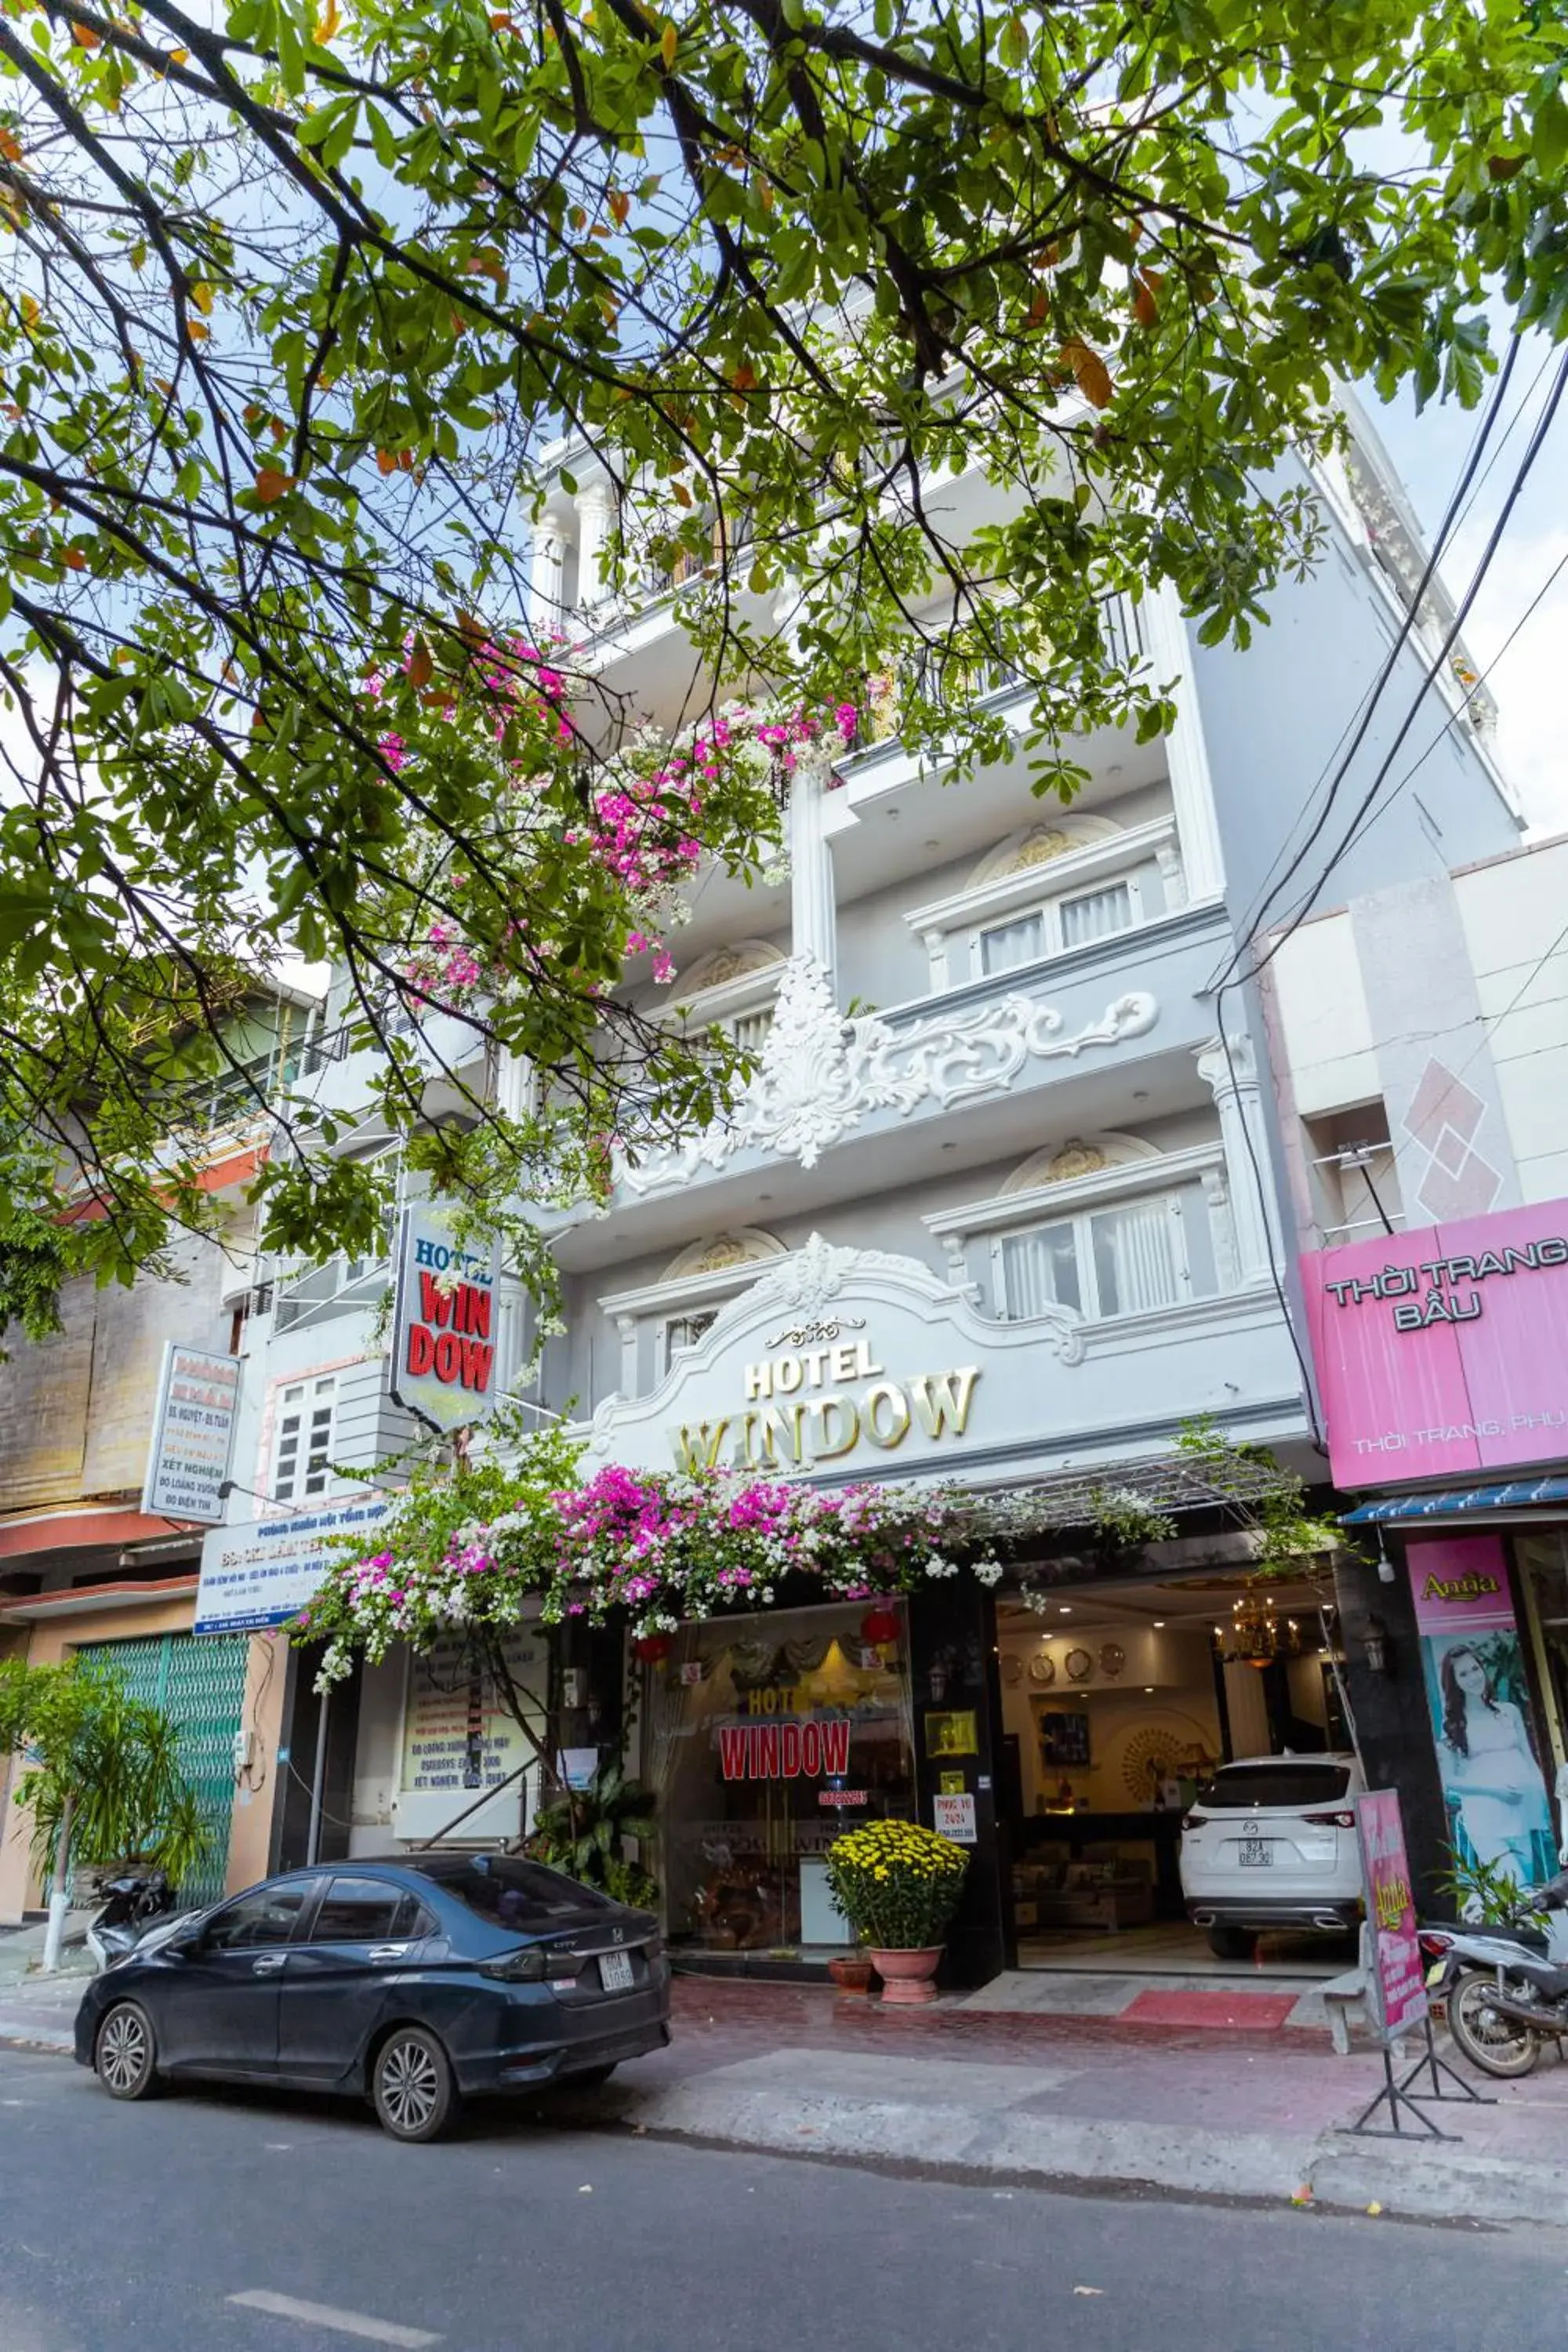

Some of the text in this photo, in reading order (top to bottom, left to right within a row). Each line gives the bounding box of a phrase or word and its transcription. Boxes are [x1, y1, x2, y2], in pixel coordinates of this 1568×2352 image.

[1326, 1238, 1568, 1307] THỜI TRANG
[419, 1271, 492, 1339] WIN
[1392, 1289, 1483, 1334] BẦU
[406, 1322, 495, 1393] DOW
[743, 1339, 885, 1403] HOTEL
[665, 1364, 982, 1472] WINDOW
[1354, 1432, 1408, 1455] THỜI
[1414, 1420, 1507, 1445] TRANG,
[162, 1457, 223, 1480] XÉT NGHIỆM
[720, 1719, 851, 1780] WINDOW
